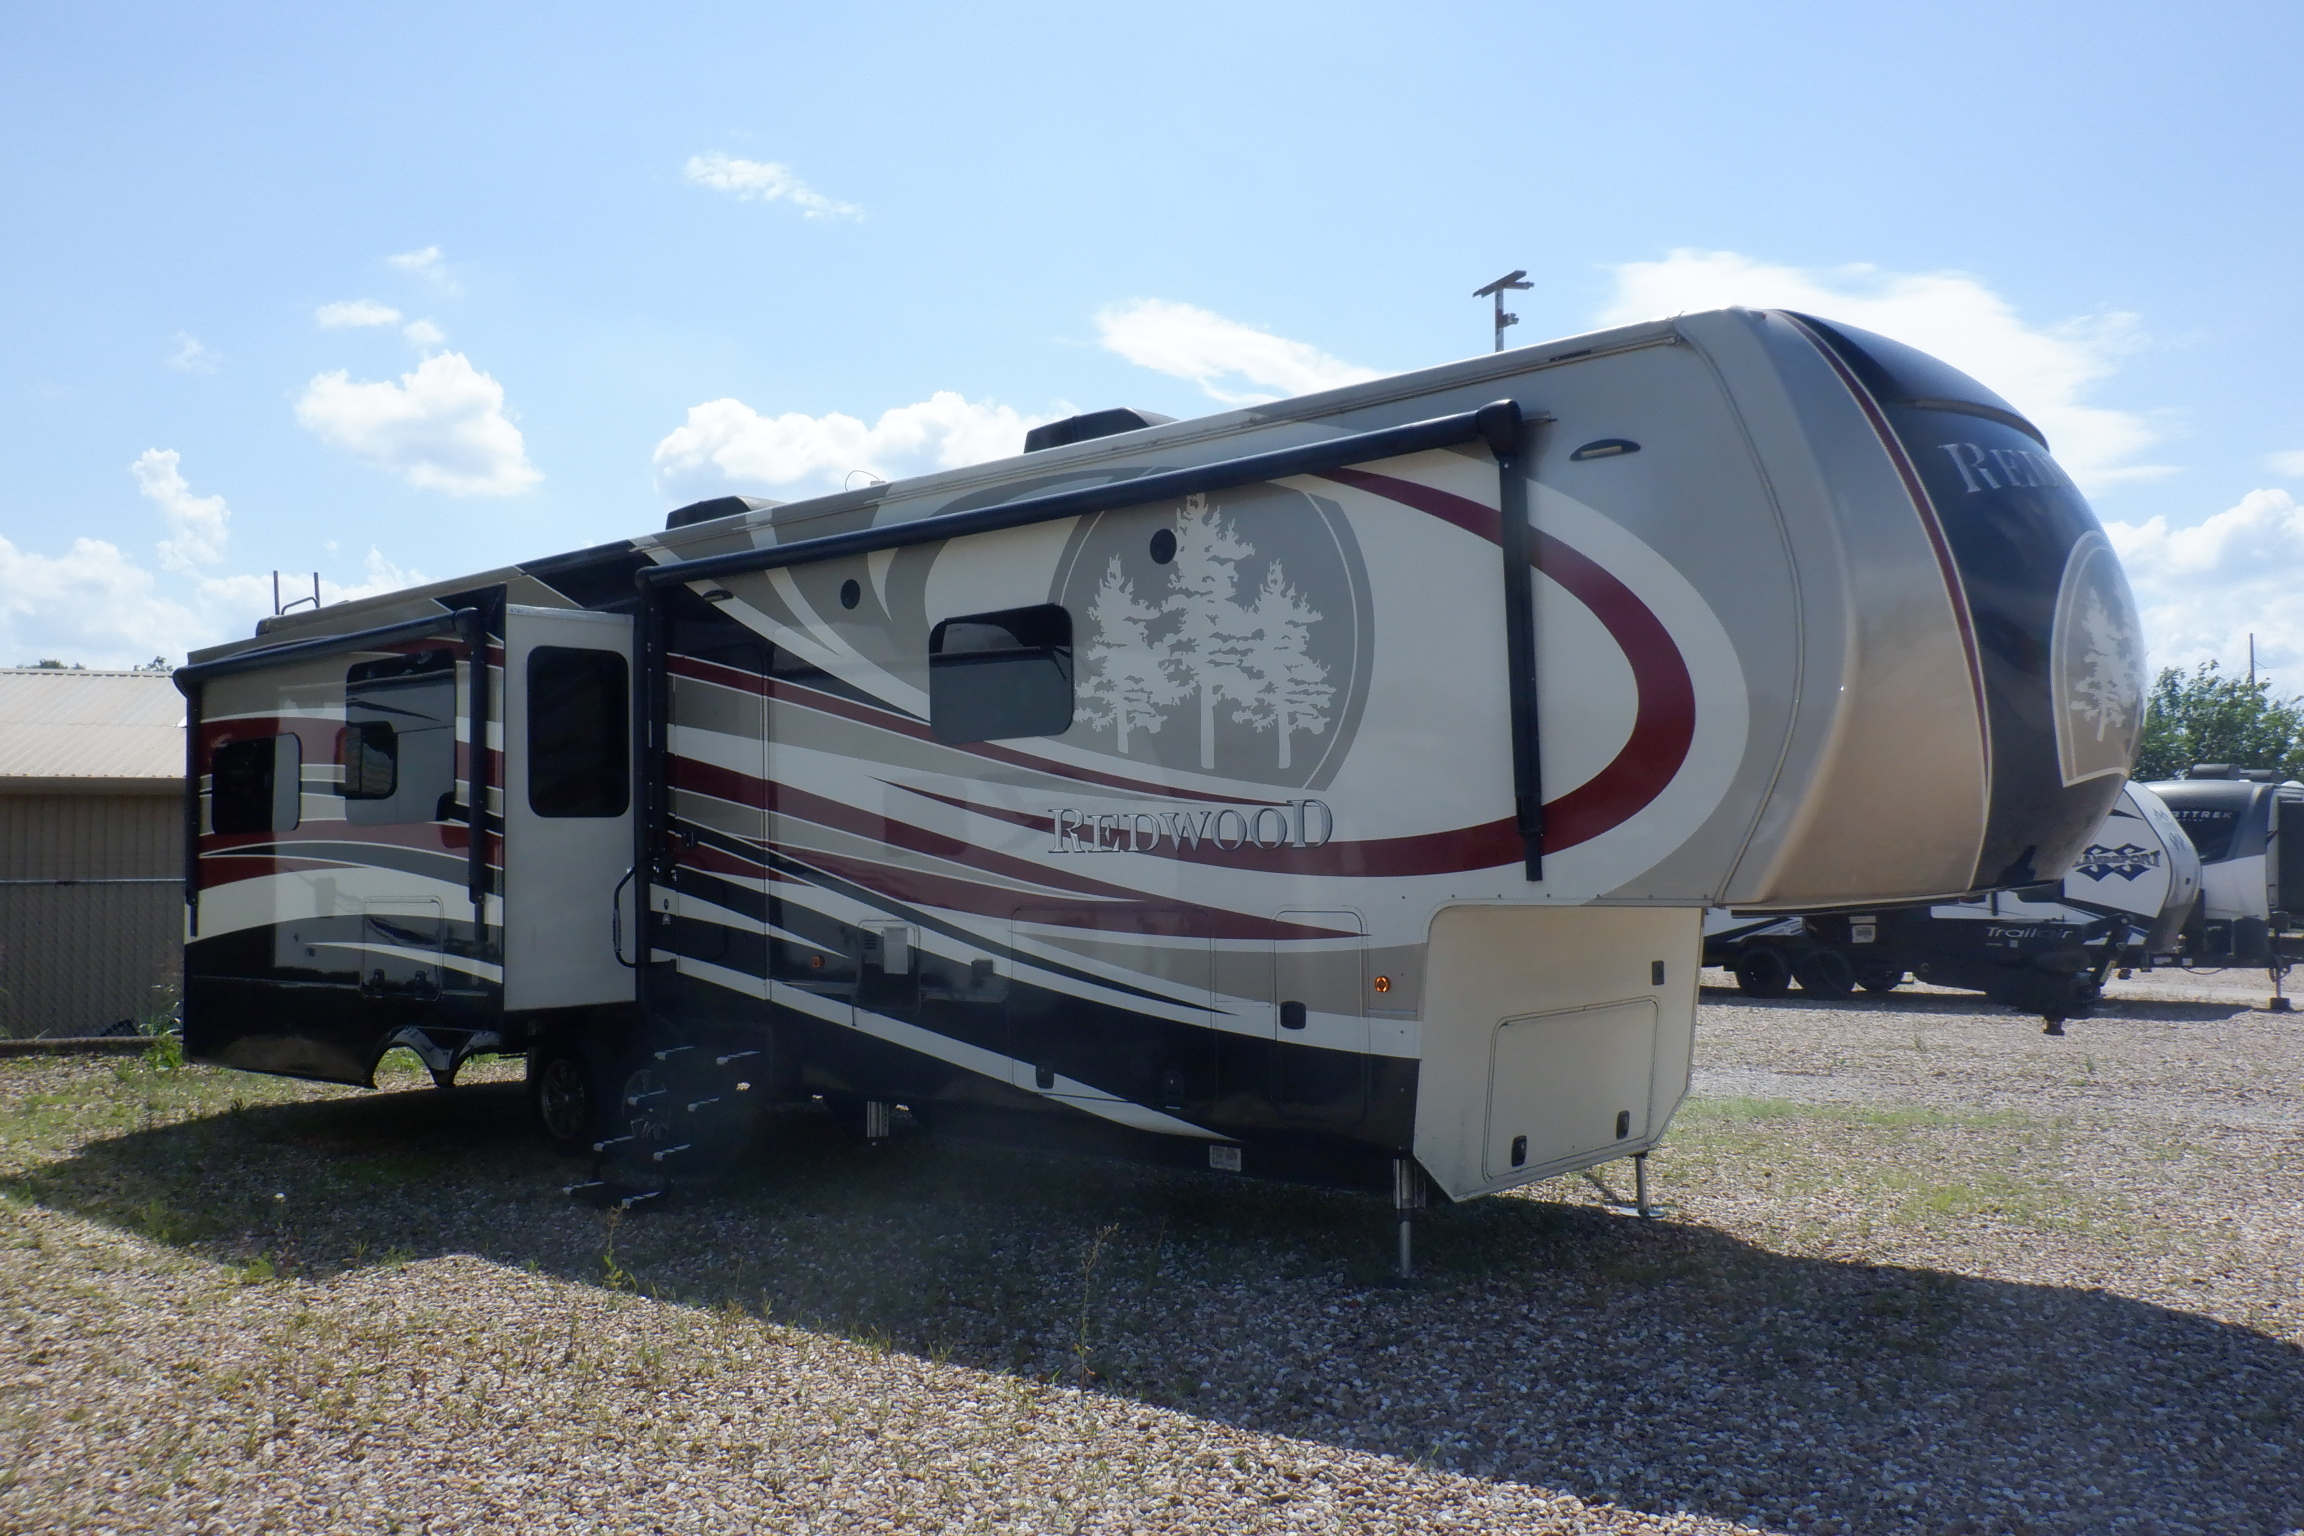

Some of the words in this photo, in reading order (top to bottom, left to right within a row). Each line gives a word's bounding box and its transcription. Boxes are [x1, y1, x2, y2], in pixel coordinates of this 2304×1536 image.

[1937, 442, 2062, 493] RED
[2172, 810, 2232, 819] RTTREK
[1047, 798, 1333, 854] REDWOOD
[2072, 850, 2161, 868] ANDSPORT
[1986, 926, 2074, 939] Trailr
